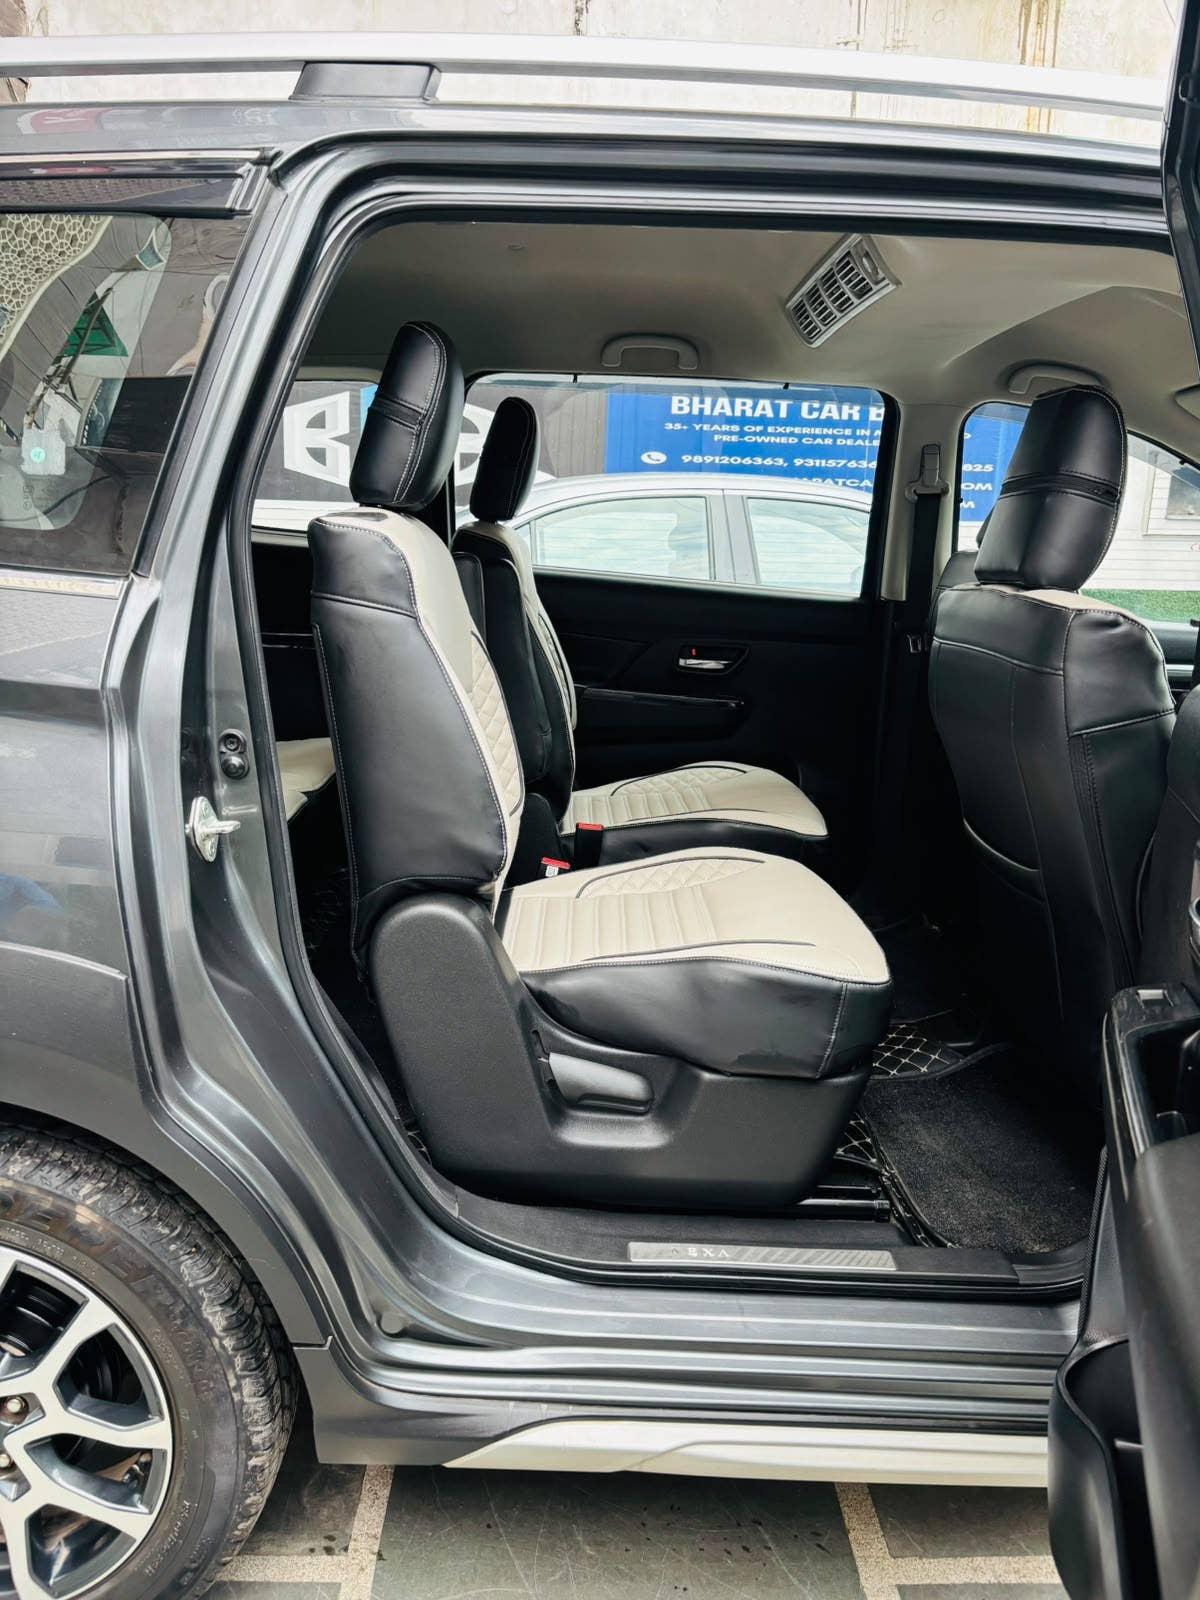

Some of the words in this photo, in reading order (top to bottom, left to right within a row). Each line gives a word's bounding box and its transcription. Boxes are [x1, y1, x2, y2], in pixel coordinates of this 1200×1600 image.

[671, 395, 793, 418] BHARAT
[801, 400, 860, 421] CAR
[664, 422, 688, 431] 35+
[693, 423, 740, 432] YEARS
[743, 424, 764, 433] OF
[767, 426, 852, 436] EXPERIENCE
[713, 434, 798, 444] PRE-OWNED
[802, 437, 833, 445] CAR
[681, 455, 788, 467] 9891206363,
